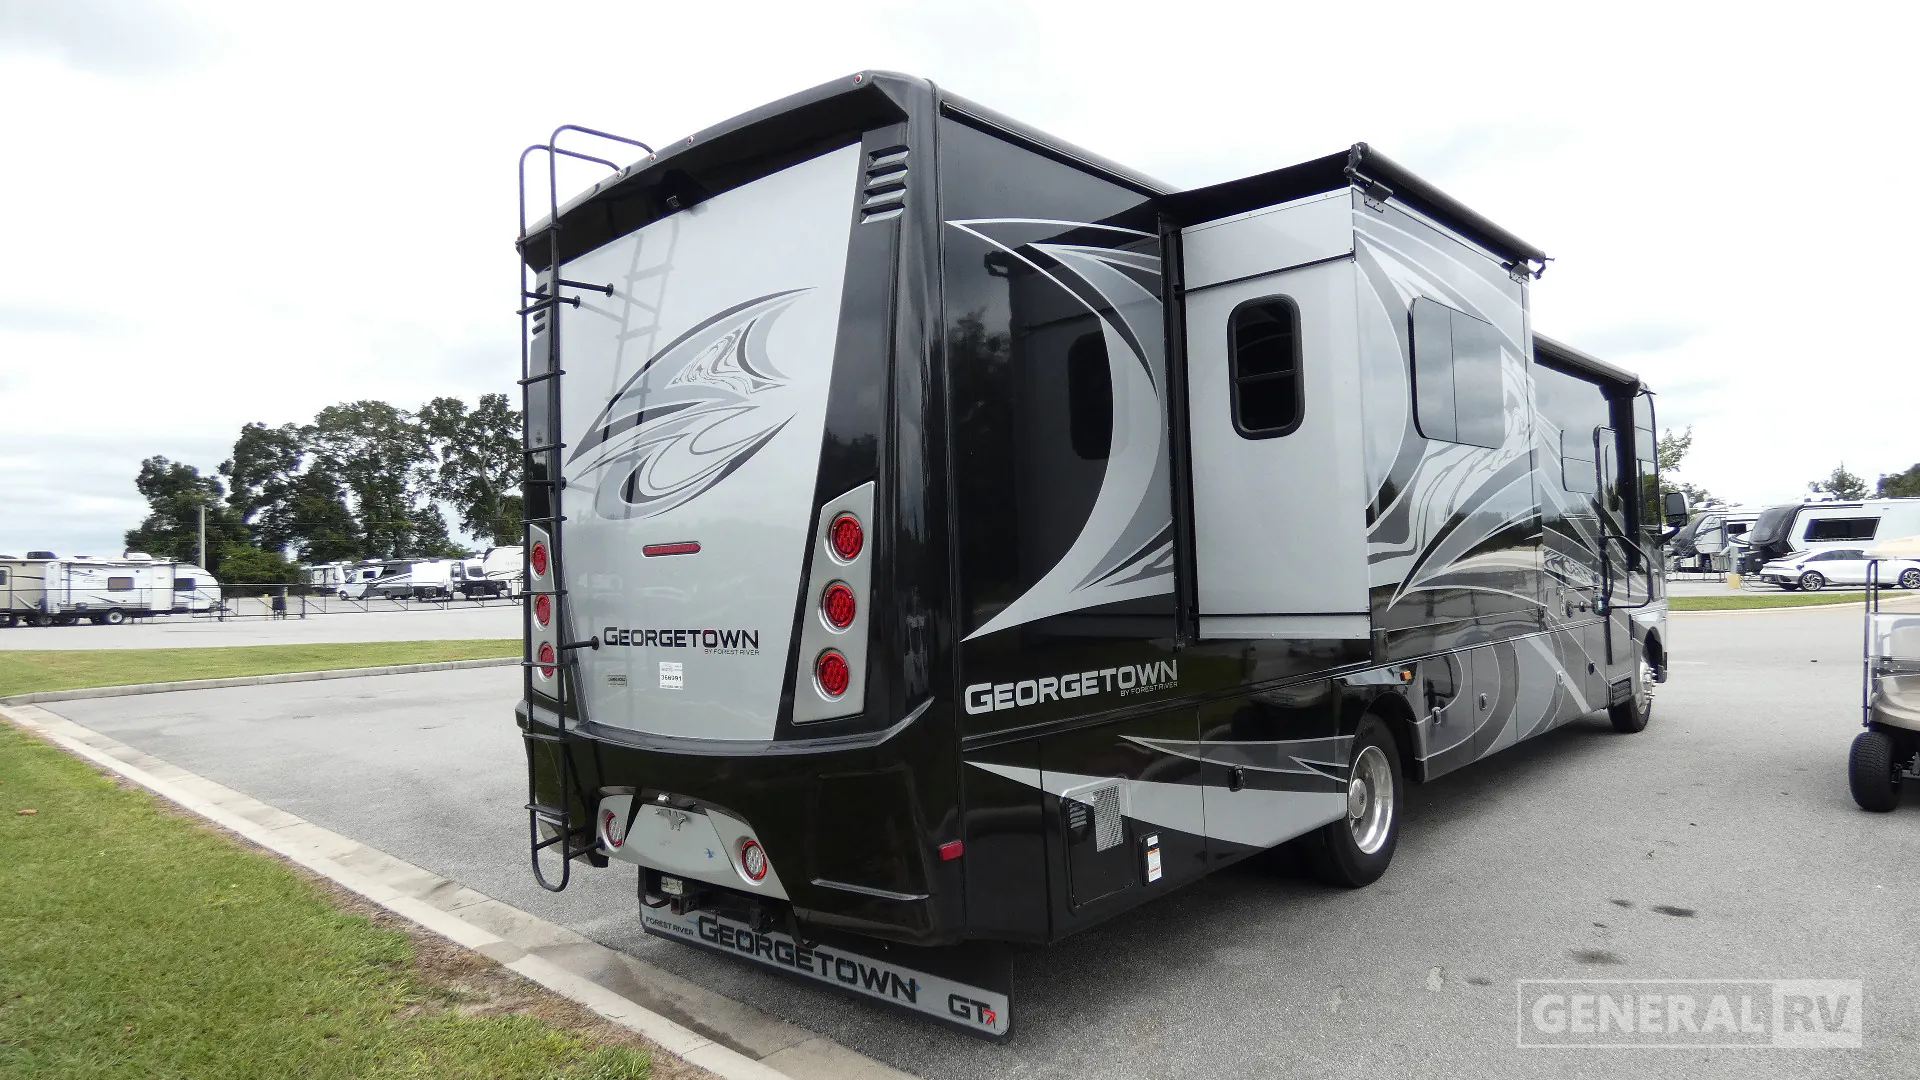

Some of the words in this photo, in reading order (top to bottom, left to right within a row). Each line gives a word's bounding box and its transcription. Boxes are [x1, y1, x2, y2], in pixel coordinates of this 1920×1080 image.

[603, 627, 759, 649] GEORGETOWN
[964, 659, 1178, 715] GEORGETOWN
[1120, 689, 1130, 697] BY
[1131, 684, 1158, 695] FOREST
[1159, 681, 1178, 690] RIVER
[645, 916, 672, 931] FOREST
[672, 924, 694, 936] RIVER
[698, 915, 917, 1003] GEORGETOWN
